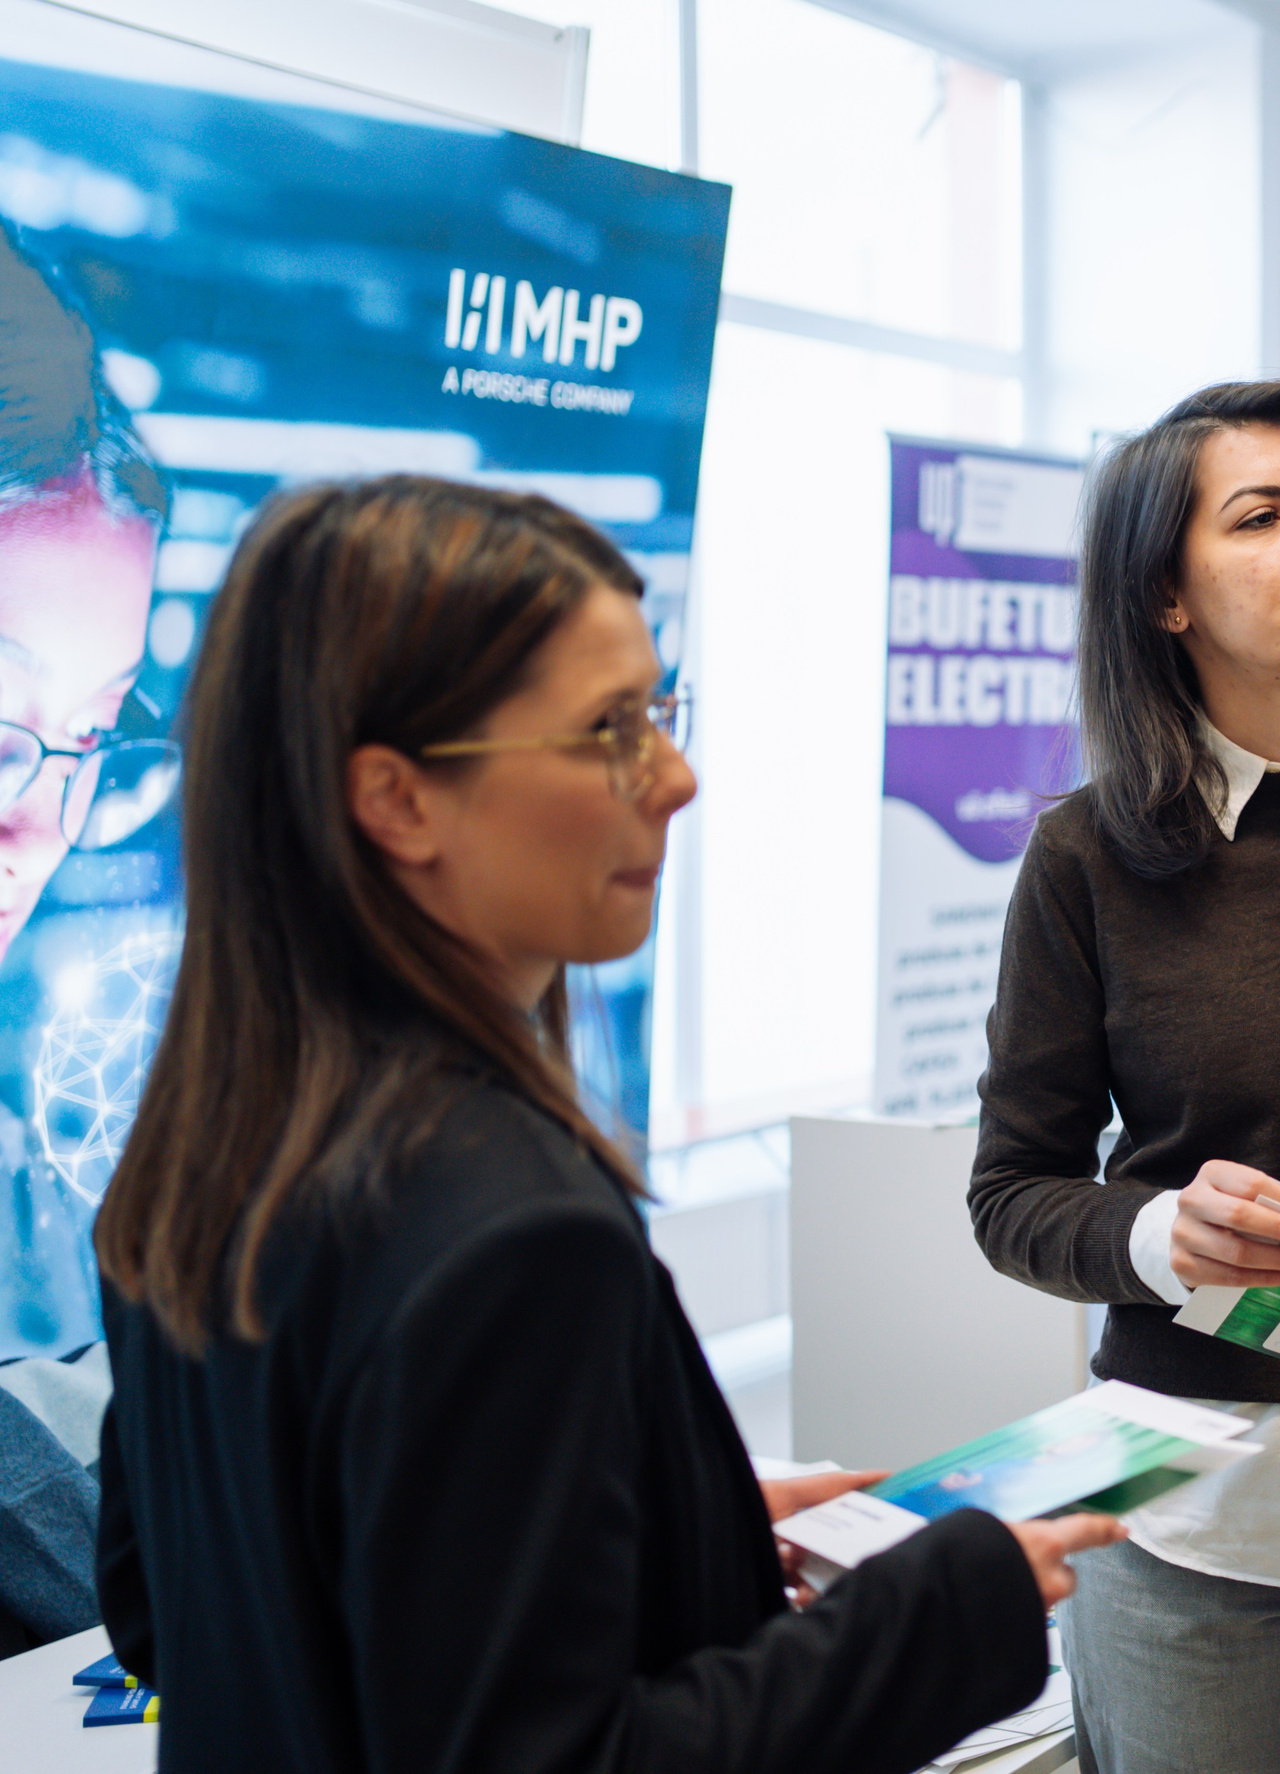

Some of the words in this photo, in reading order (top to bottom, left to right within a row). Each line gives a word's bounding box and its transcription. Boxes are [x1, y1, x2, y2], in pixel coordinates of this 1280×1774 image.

[510, 279, 643, 372] MHP
[441, 366, 459, 394] A
[461, 368, 550, 406] PORSCHE
